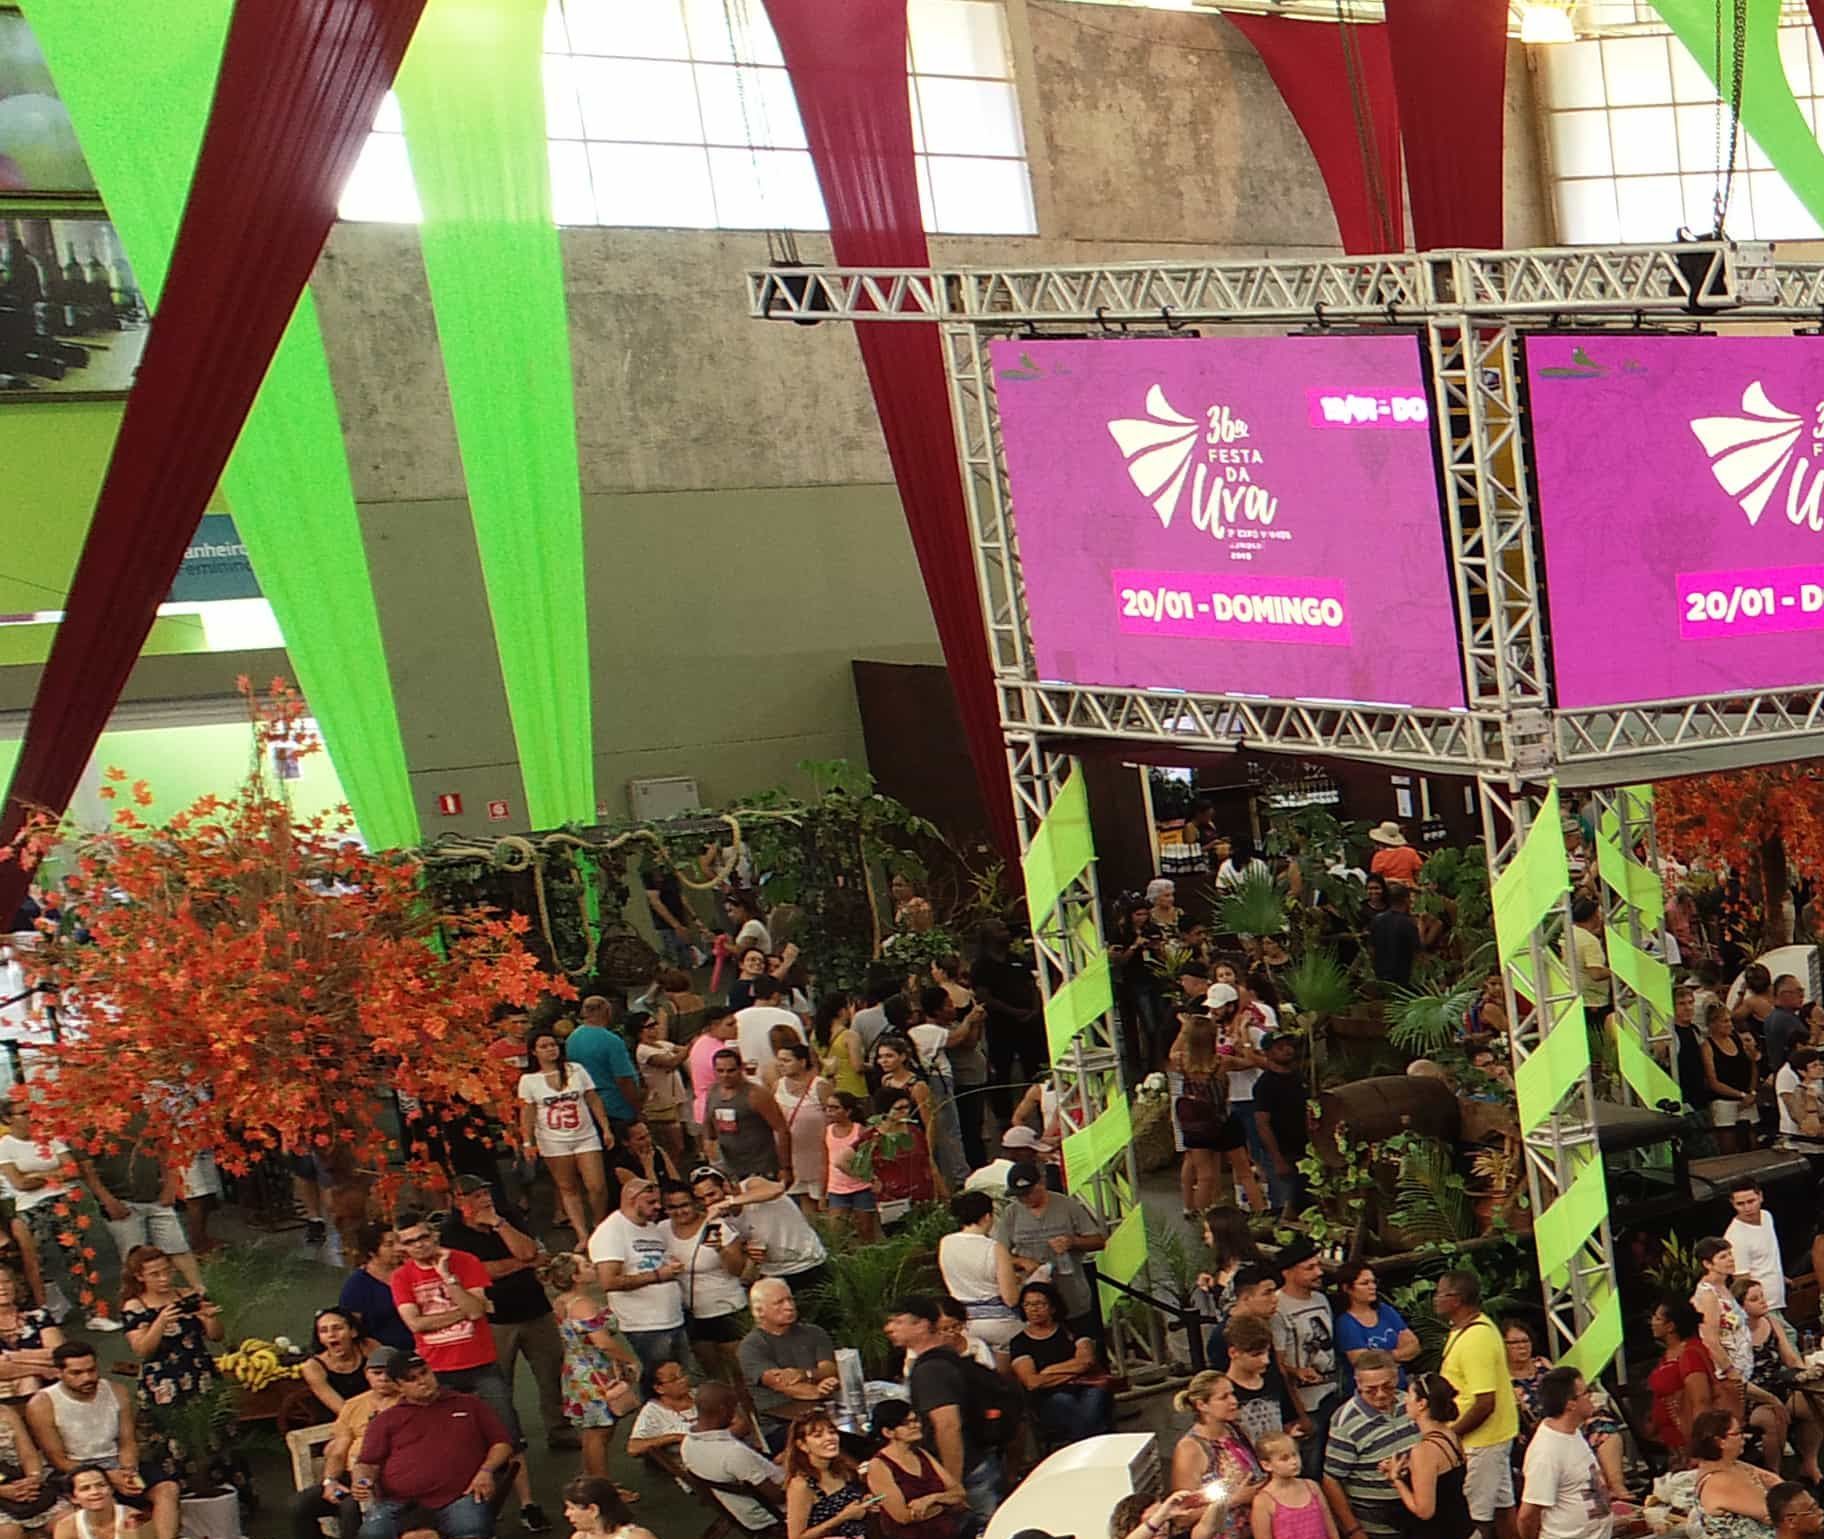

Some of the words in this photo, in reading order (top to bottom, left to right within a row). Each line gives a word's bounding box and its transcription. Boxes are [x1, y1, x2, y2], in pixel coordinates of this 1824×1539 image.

[1208, 449, 1264, 465] FESTA
[1225, 467, 1250, 483] DA
[1191, 463, 1278, 540] Uva
[1121, 588, 1194, 622] 20/01
[1212, 592, 1344, 628] DOMINGO
[1685, 587, 1775, 624] 20/01
